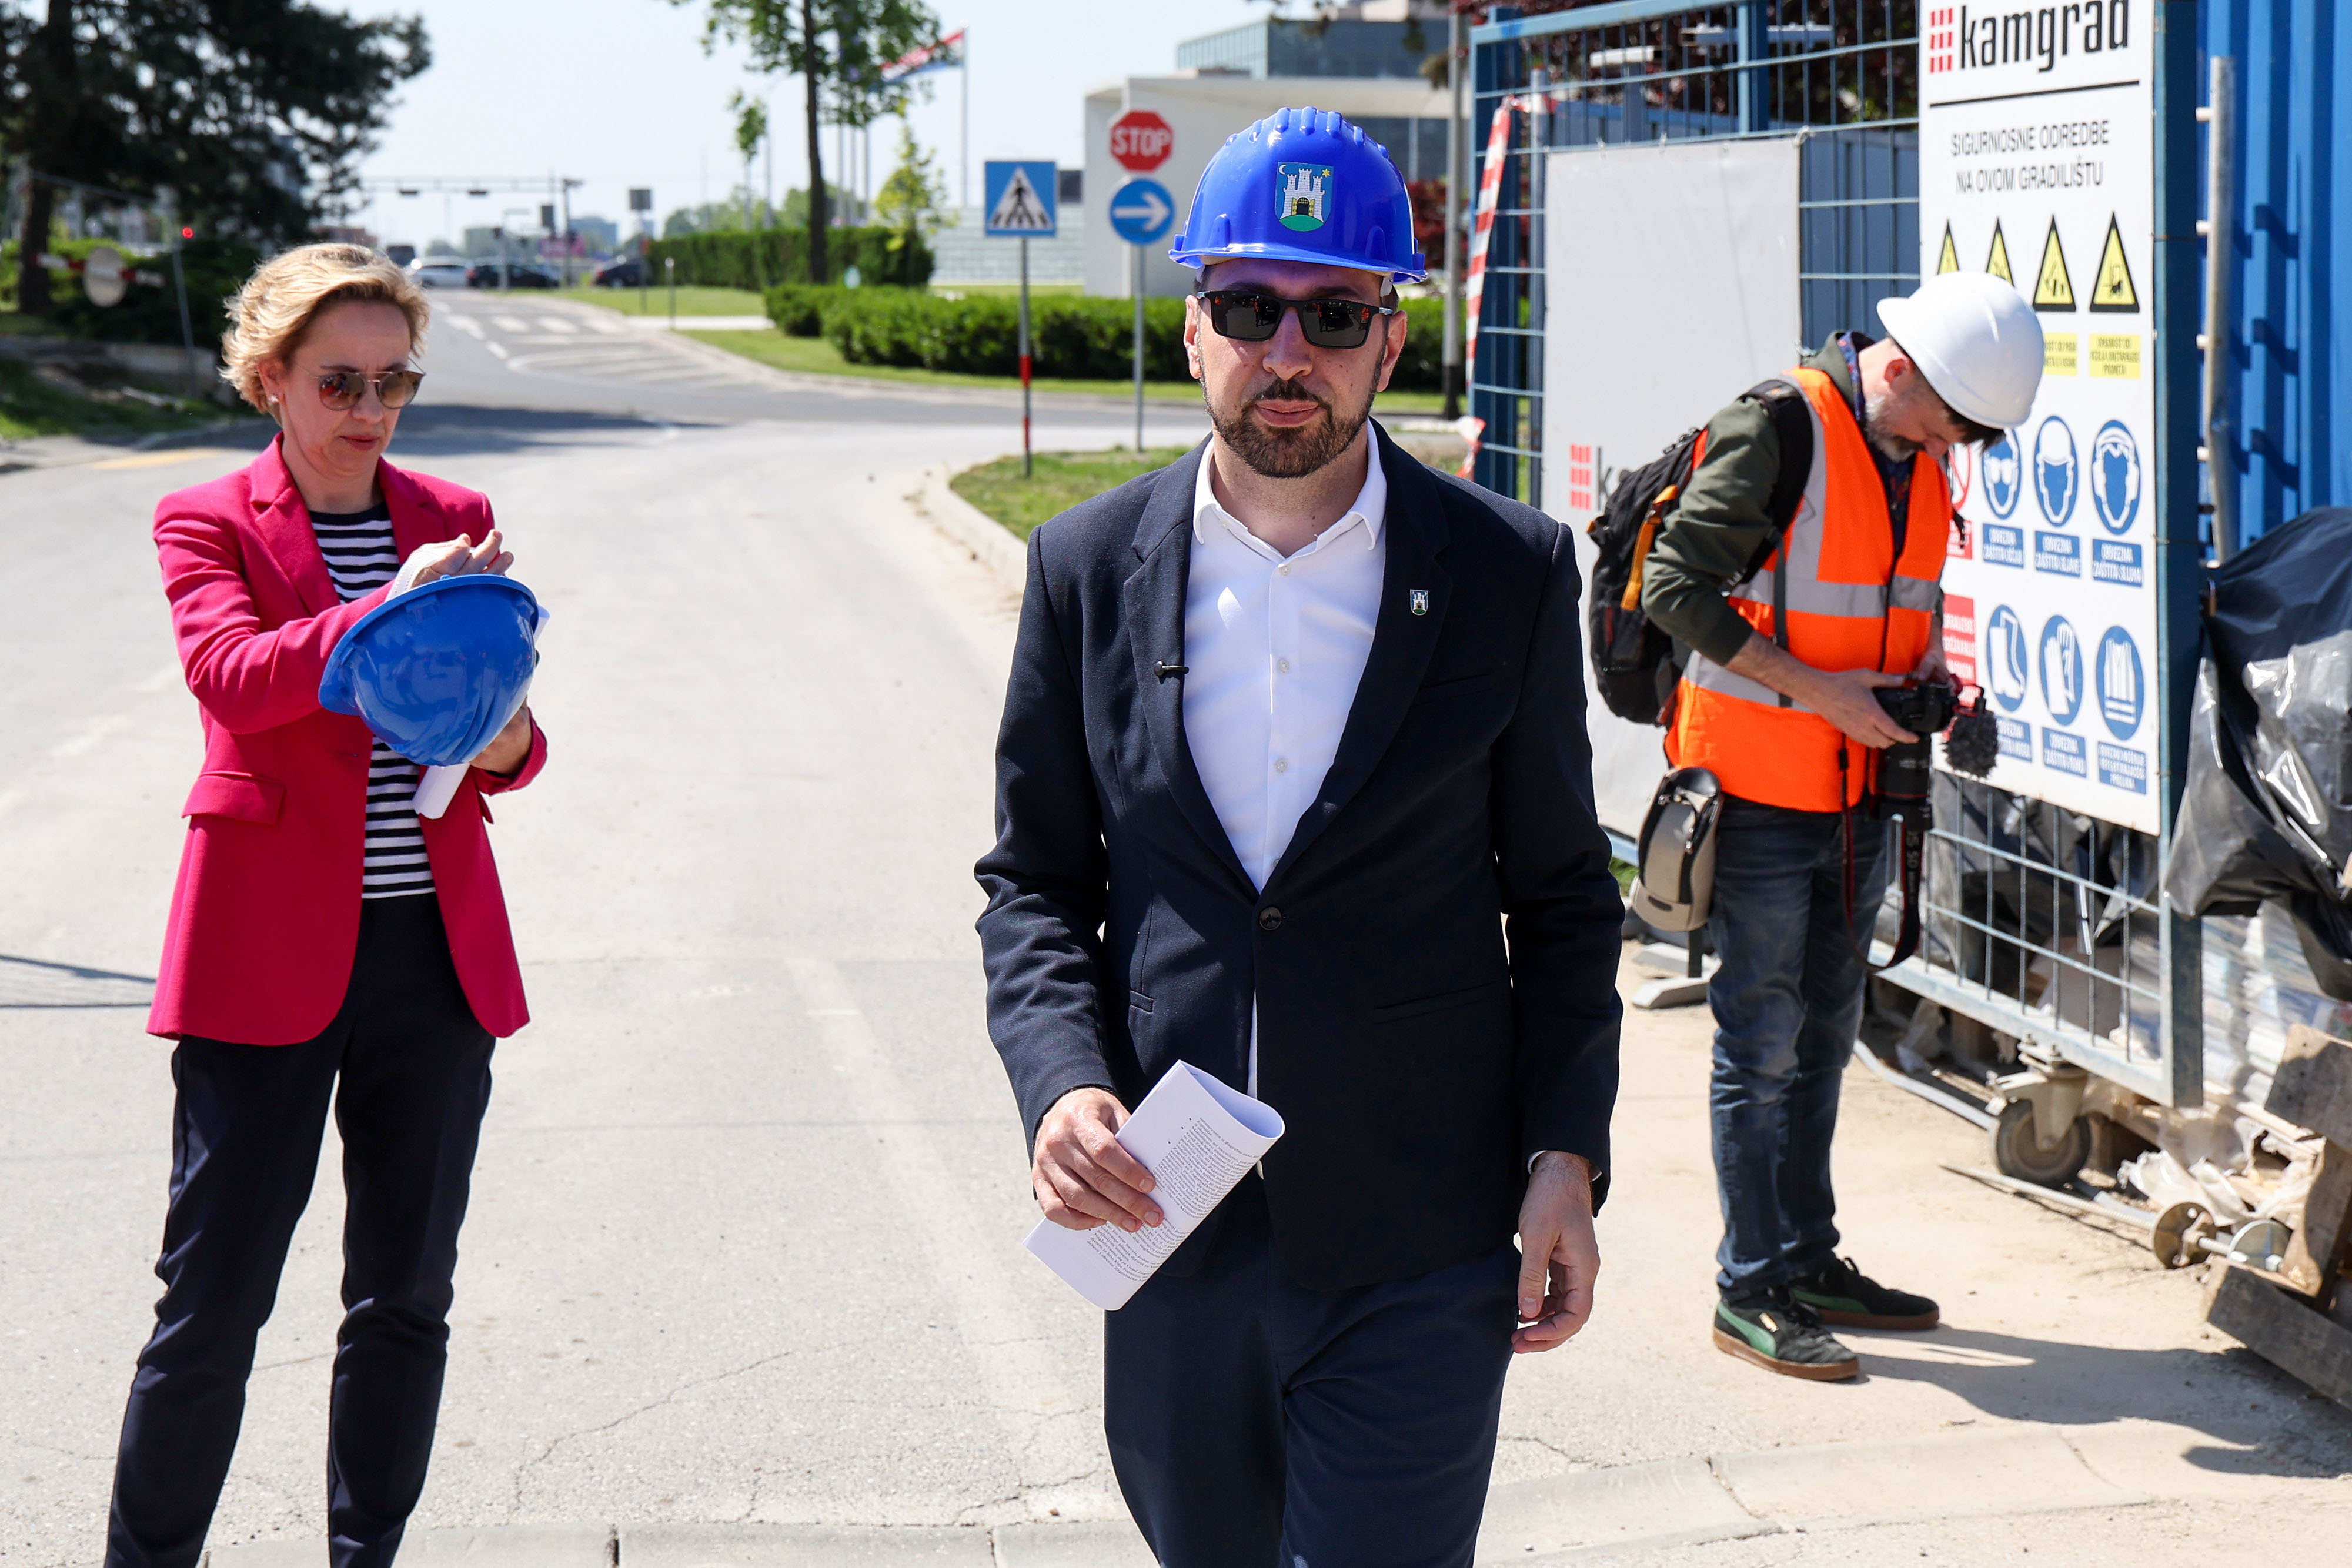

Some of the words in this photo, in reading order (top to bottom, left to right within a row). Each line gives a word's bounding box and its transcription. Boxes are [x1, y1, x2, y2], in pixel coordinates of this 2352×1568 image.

[1960, 0, 2128, 73] kamgrad
[1111, 127, 1172, 156] STOP
[1951, 127, 2035, 157] SIGURNOSNE
[2040, 120, 2109, 149] ODREDBE
[1956, 171, 1973, 195] NA
[1976, 168, 2015, 193] OVOM
[2019, 154, 2104, 190] GRADILIŠTU
